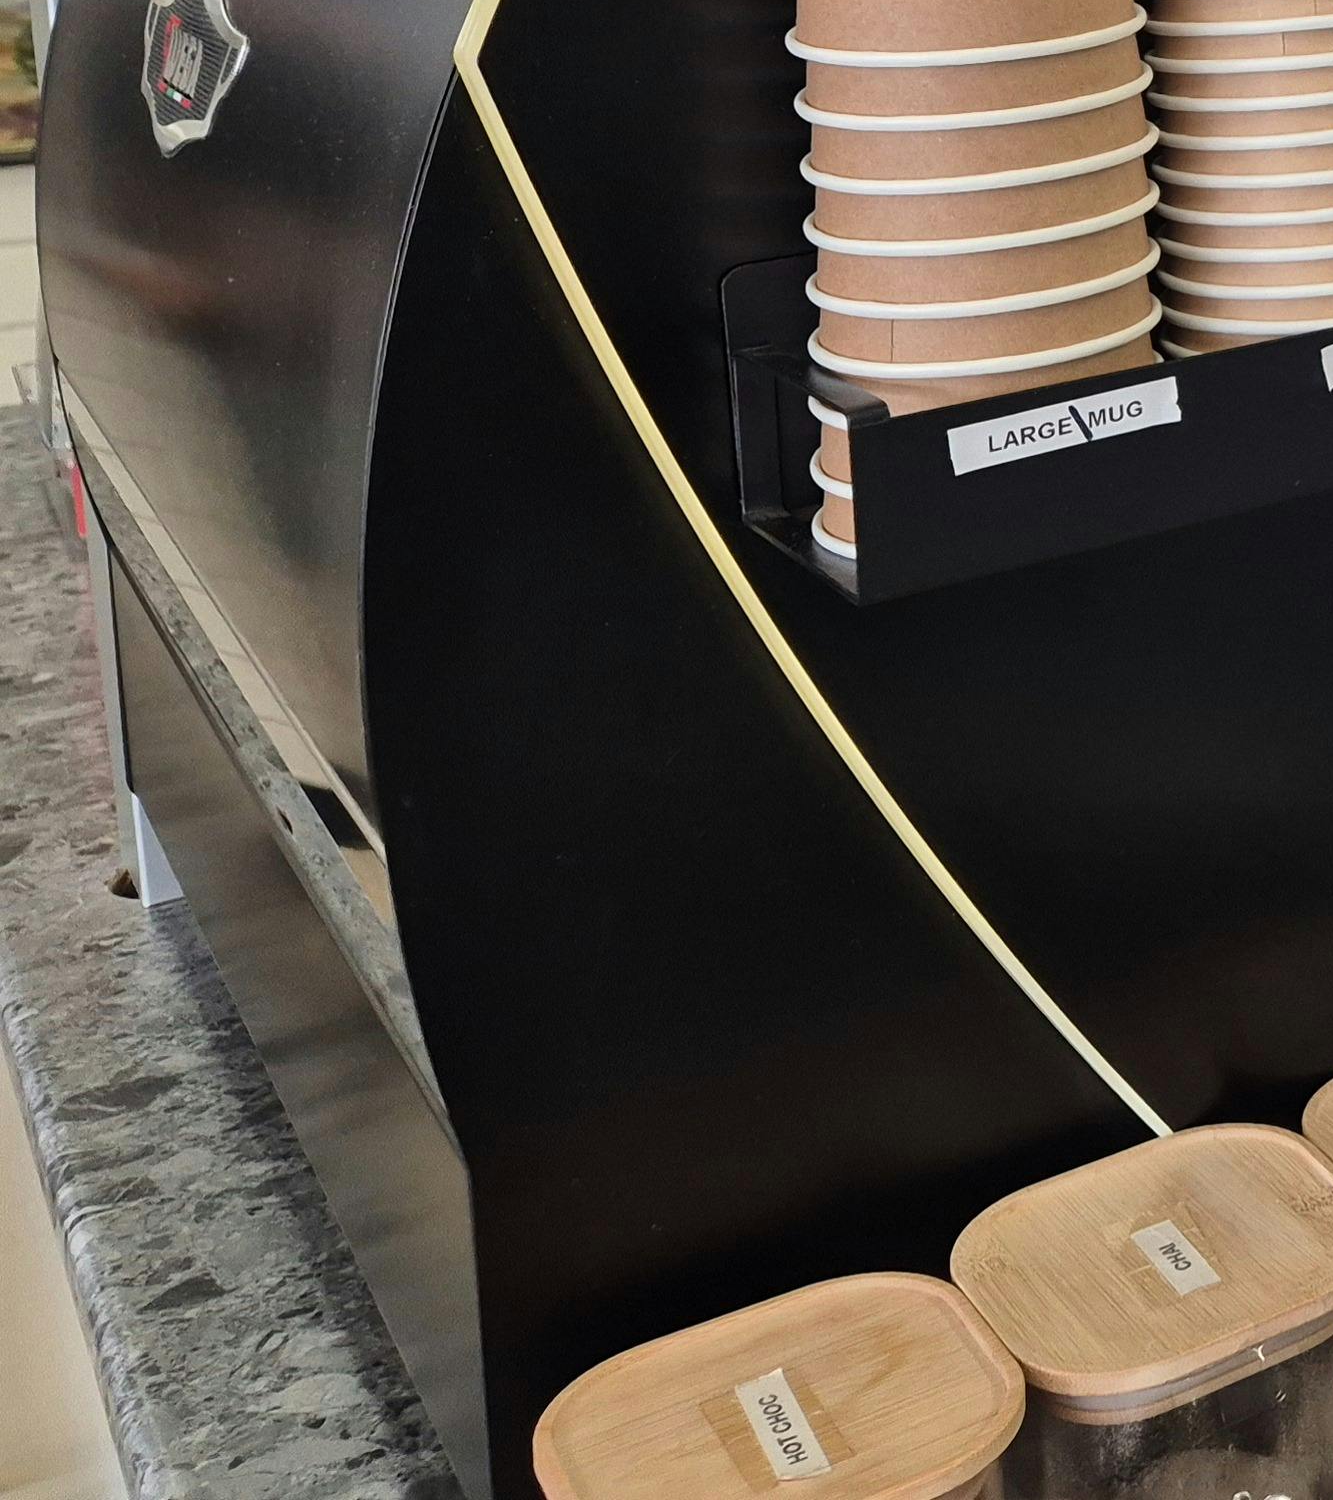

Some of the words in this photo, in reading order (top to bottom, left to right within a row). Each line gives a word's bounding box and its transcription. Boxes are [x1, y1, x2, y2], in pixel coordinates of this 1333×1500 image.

[988, 416, 1073, 452] LARGE
[1088, 400, 1143, 428] MUG
[1159, 1242, 1192, 1271] CHAI
[758, 1394, 792, 1433] CHOC
[777, 1435, 809, 1465] HOT
